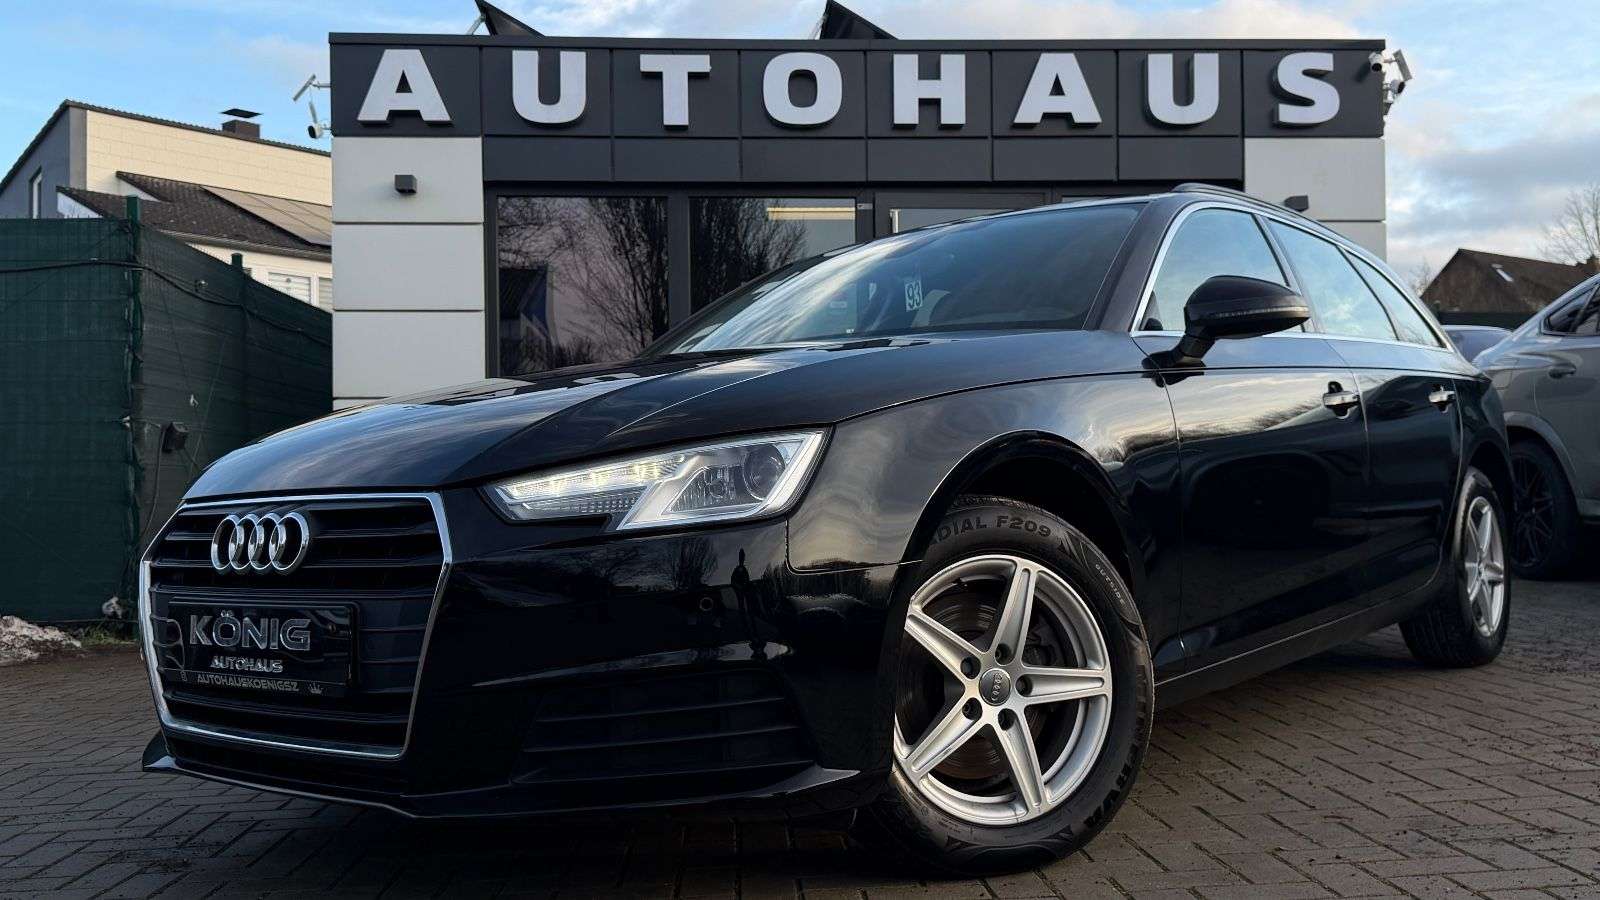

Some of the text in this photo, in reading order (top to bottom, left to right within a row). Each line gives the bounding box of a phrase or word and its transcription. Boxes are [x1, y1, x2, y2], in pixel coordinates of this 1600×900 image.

[356, 48, 1341, 126] AUTOHAUS
[906, 280, 921, 310] 93
[934, 515, 1052, 541] DIAL F209
[189, 609, 312, 652] KÖNIG
[209, 655, 284, 674] AUTOHAUS
